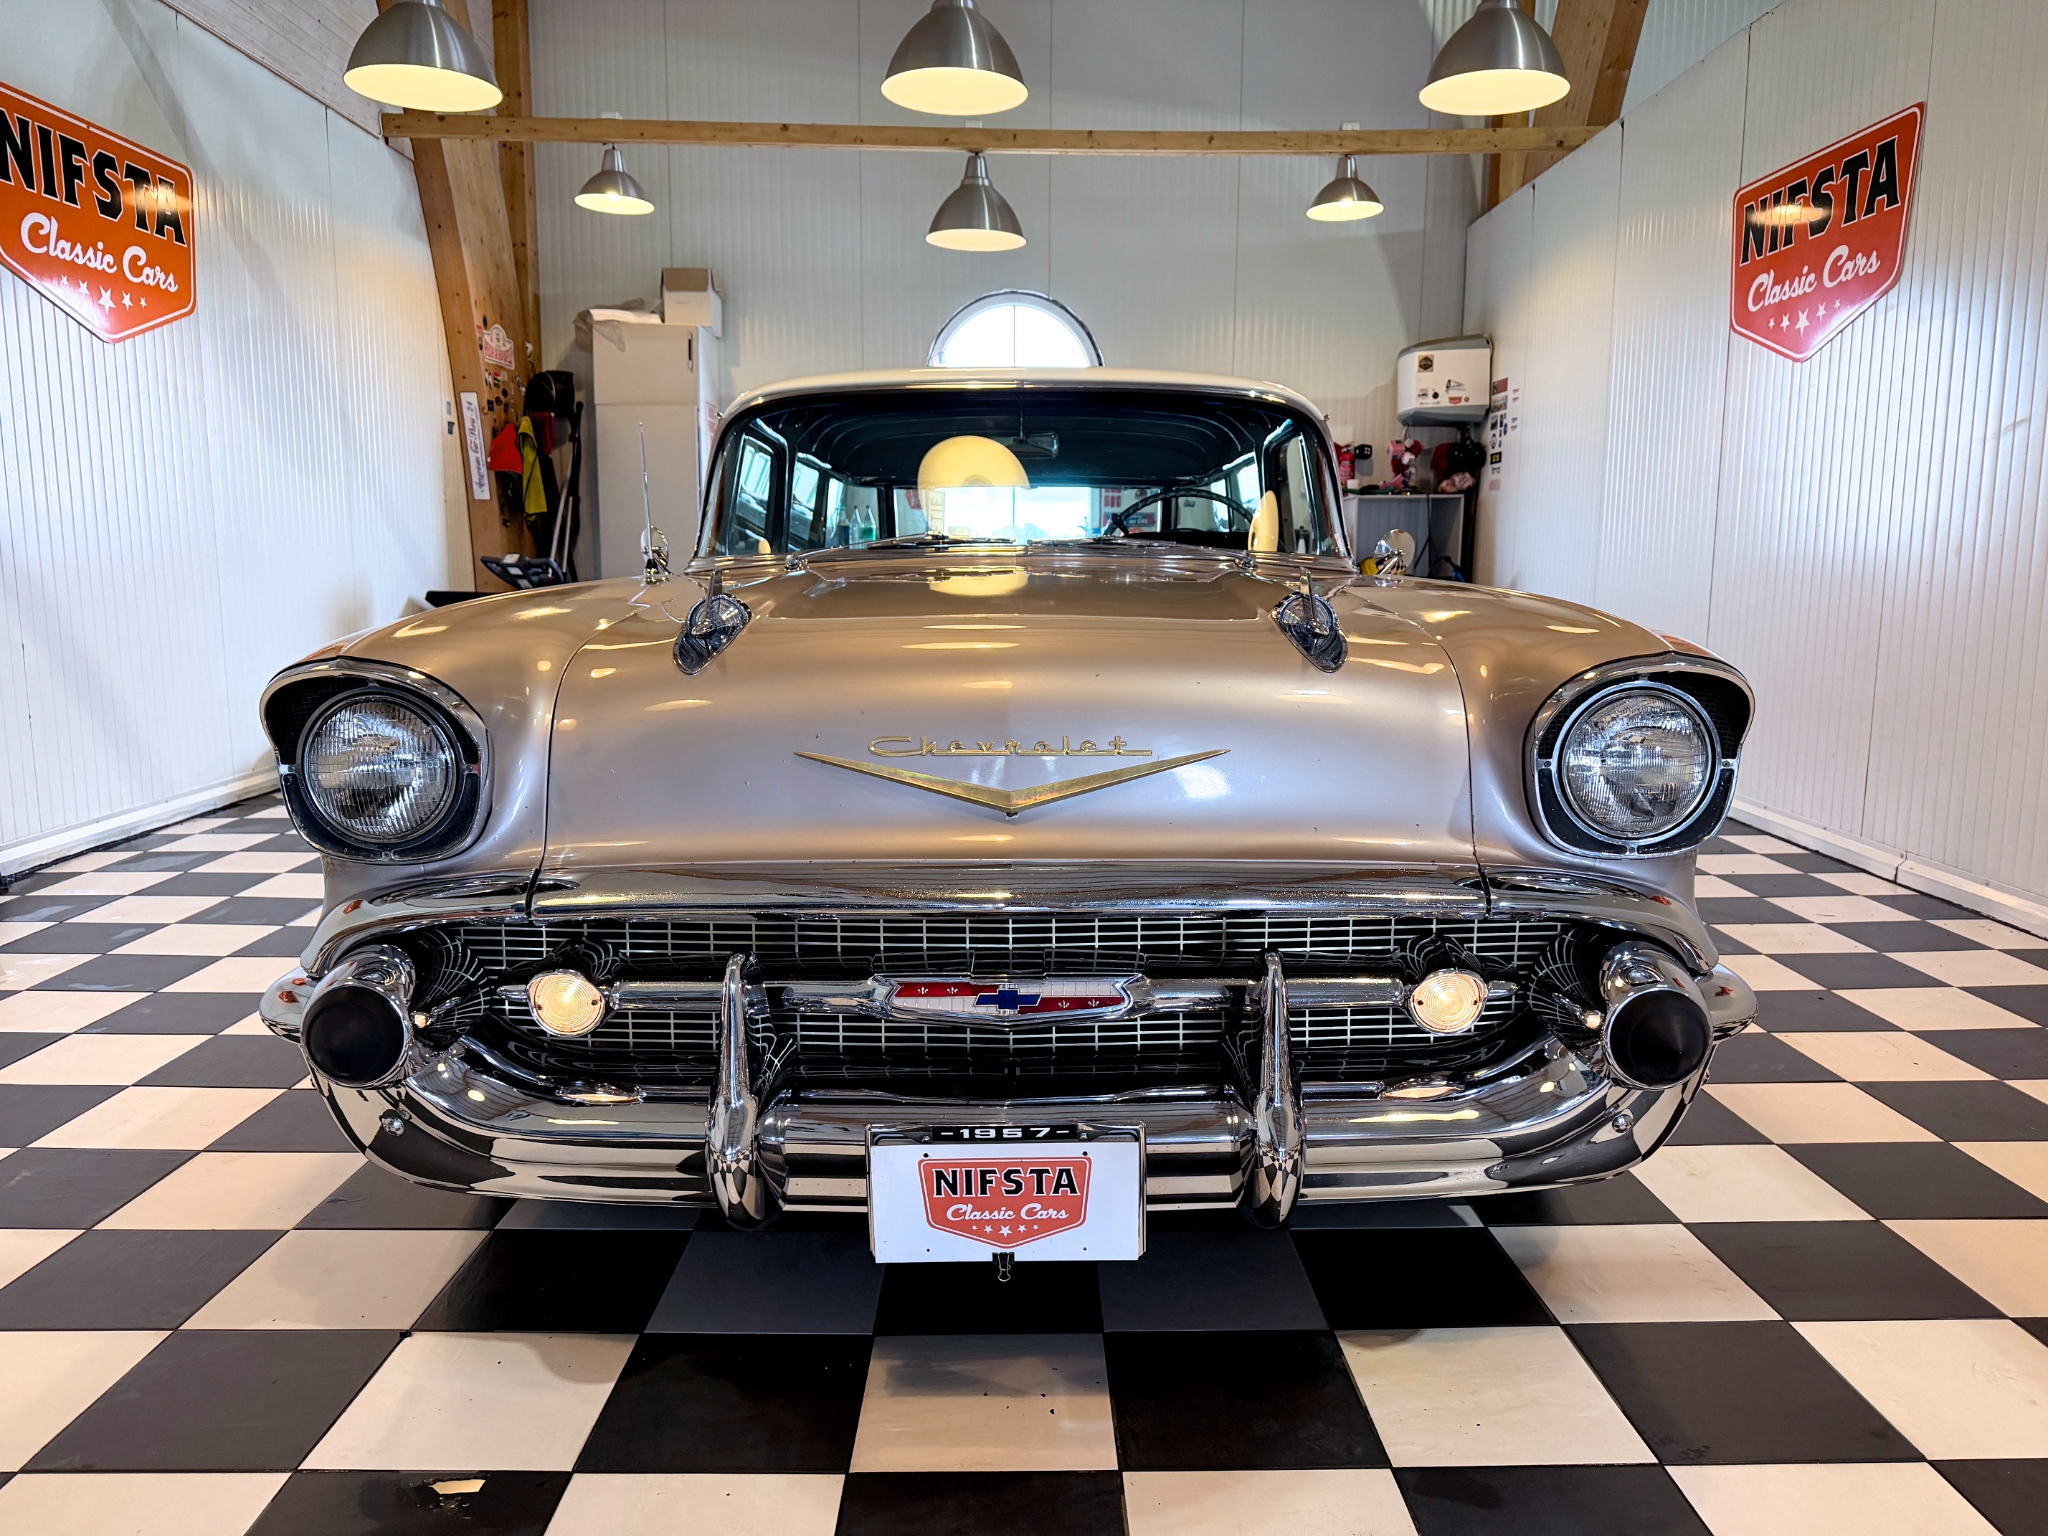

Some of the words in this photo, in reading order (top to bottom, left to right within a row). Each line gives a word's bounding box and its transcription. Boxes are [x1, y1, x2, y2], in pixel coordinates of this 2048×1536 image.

[0, 107, 188, 247] NIFSTA
[1739, 134, 1902, 267] NIFSTA
[20, 212, 117, 273] Classic
[122, 245, 179, 292] Cars
[1747, 265, 1818, 312] Classic
[1823, 244, 1881, 289] Cars
[466, 399, 475, 412] 24
[469, 440, 480, 455] Car
[868, 735, 1152, 757] Chevrolet
[932, 1166, 1081, 1198] NIFSTA
[946, 1203, 1016, 1221] Classic
[1020, 1203, 1069, 1220] Cars
